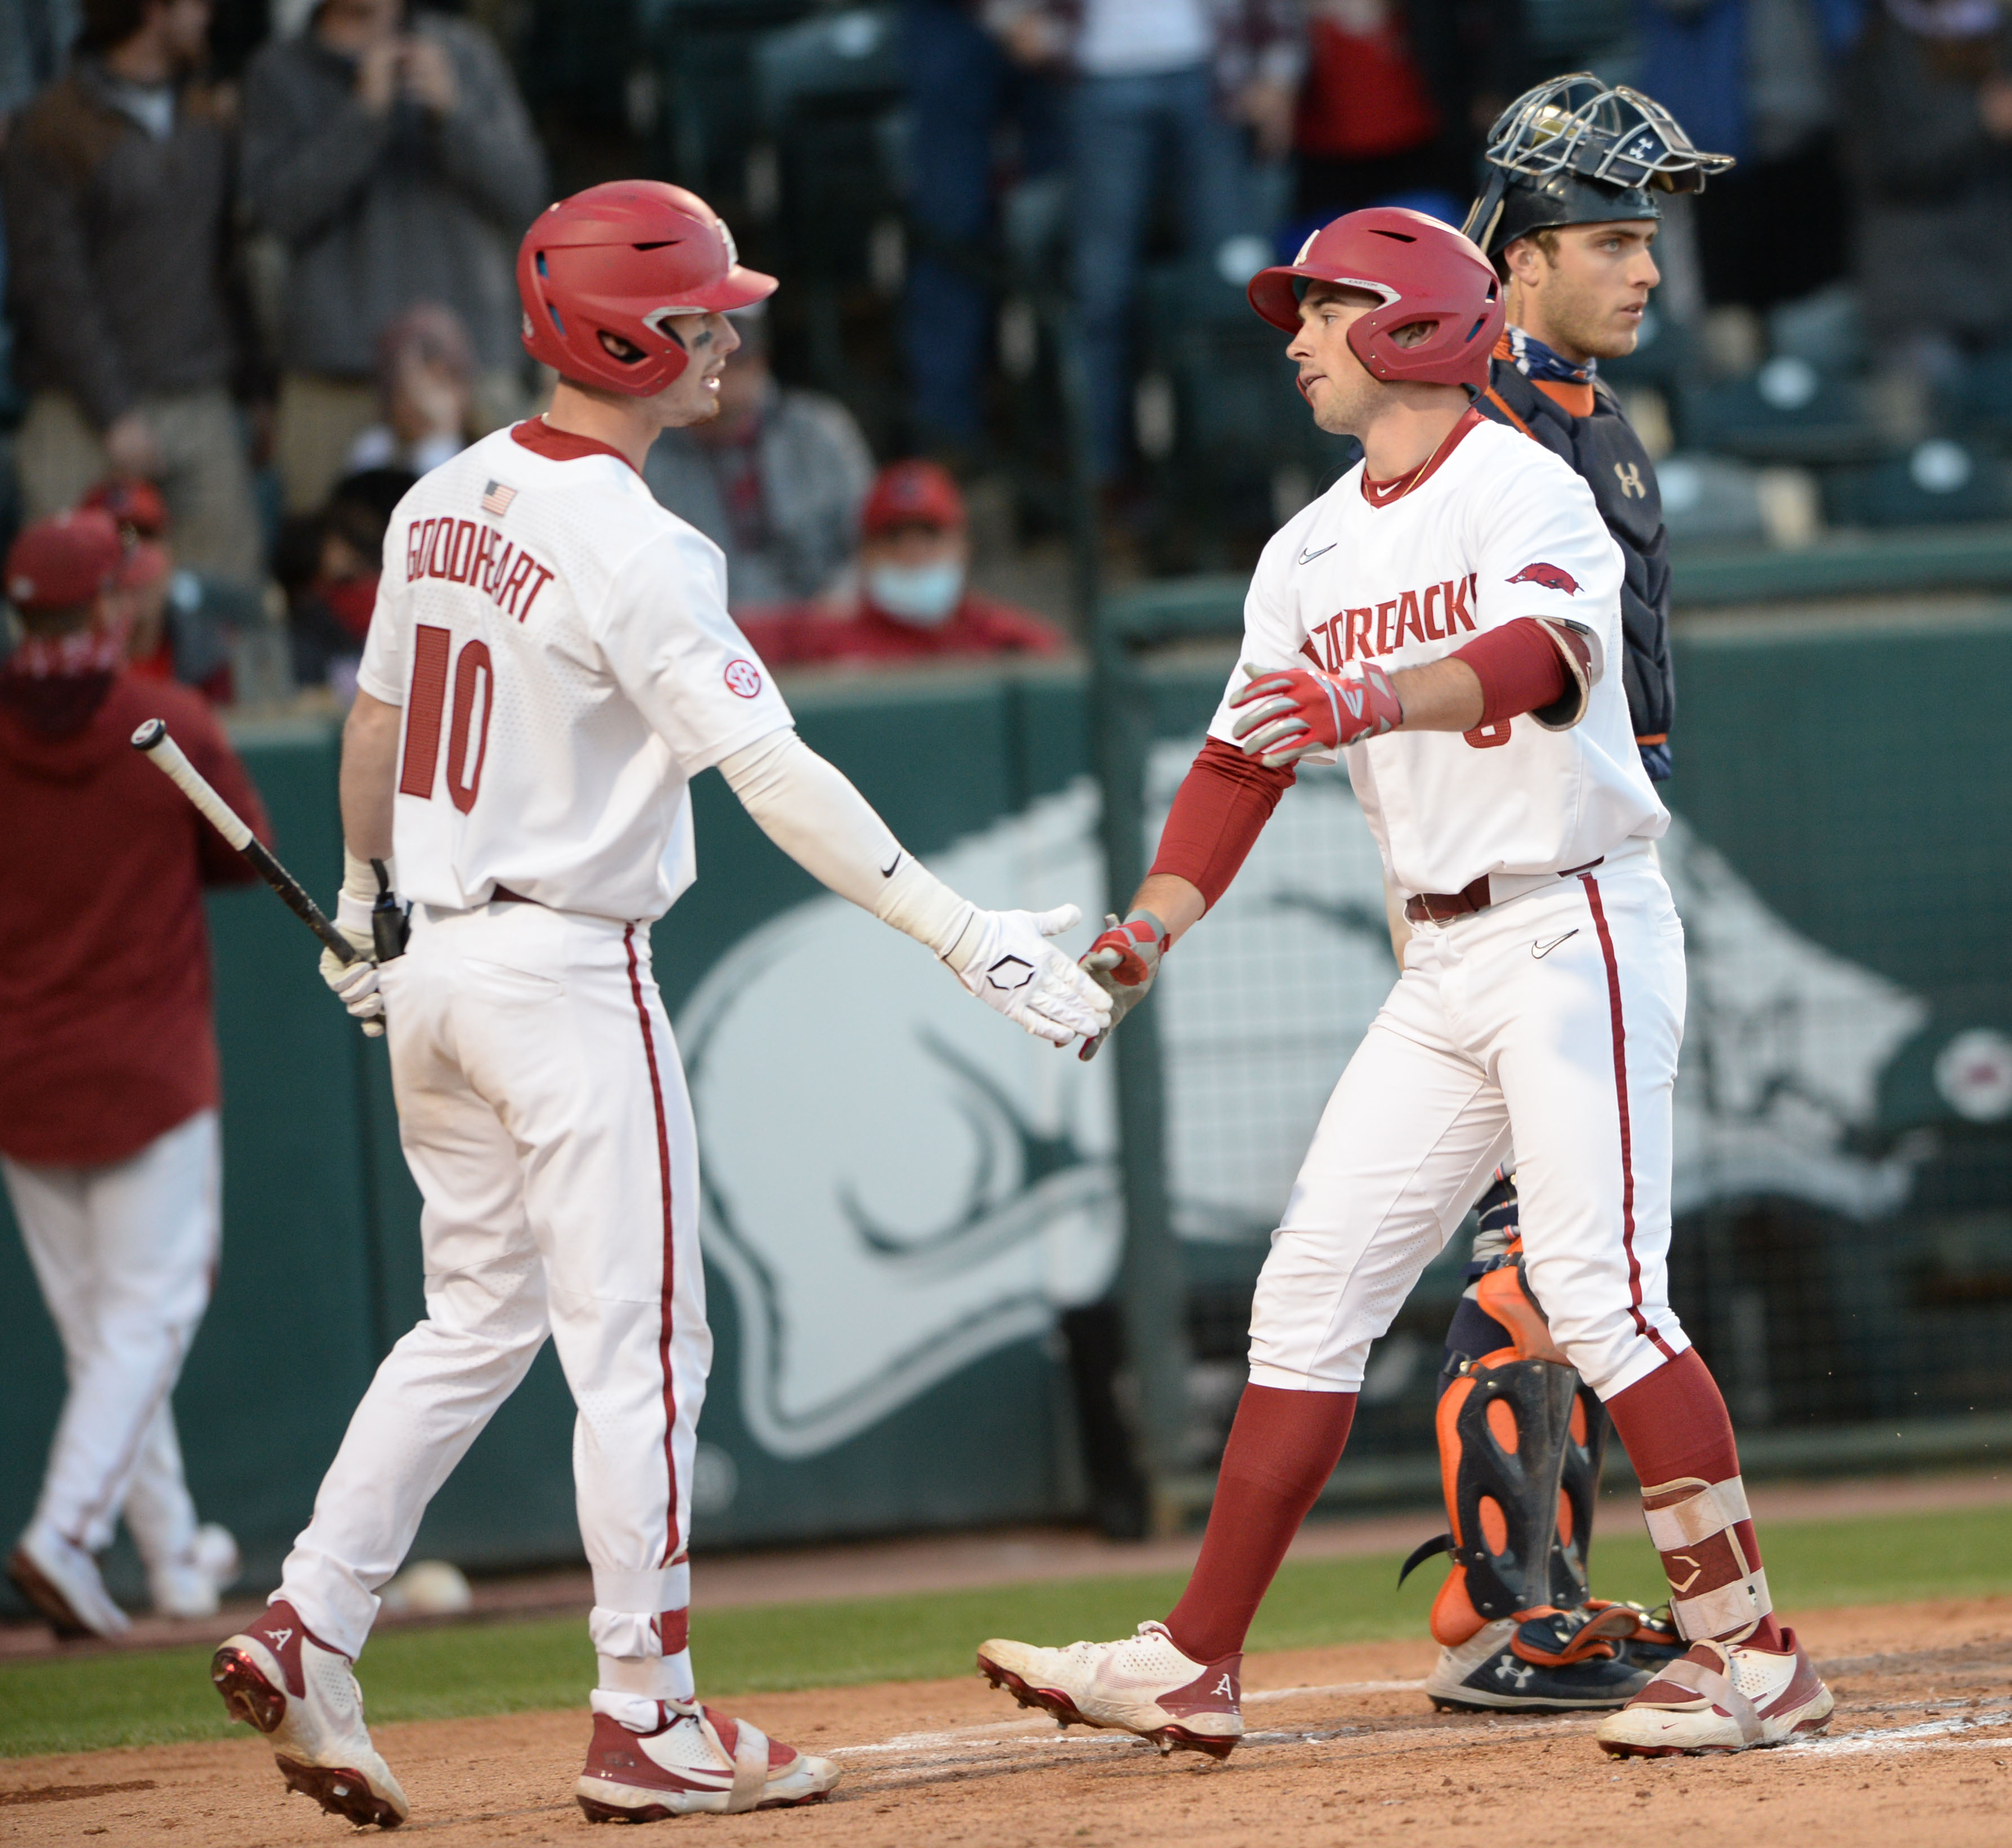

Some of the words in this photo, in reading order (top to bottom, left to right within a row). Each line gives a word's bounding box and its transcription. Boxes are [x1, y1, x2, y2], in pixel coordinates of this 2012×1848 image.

[407, 517, 555, 624] GOODHEART
[399, 624, 494, 816] 10
[264, 1627, 292, 1651] A
[1210, 1673, 1234, 1700] A
